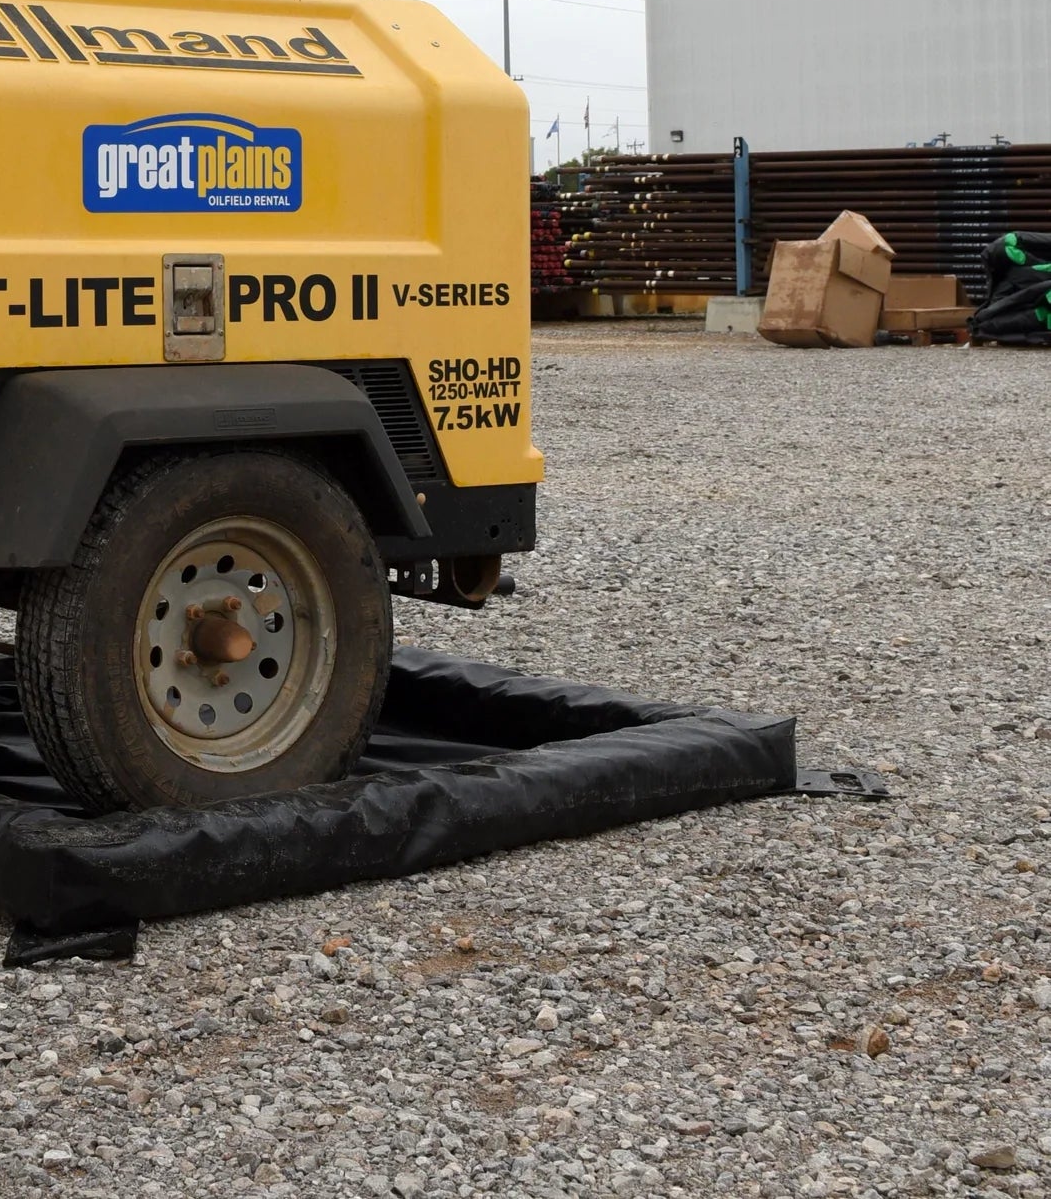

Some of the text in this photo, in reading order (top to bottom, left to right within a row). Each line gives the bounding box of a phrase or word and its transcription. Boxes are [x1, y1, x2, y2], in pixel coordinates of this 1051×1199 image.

[98, 136, 291, 198] great plains
[208, 195, 290, 206] OILFIELD RENTAL
[229, 274, 337, 322] PRO
[352, 275, 378, 320] II
[392, 283, 510, 307] V-SERIES
[428, 357, 521, 383] SHO-HD
[428, 381, 521, 401] 1250-WATT
[433, 403, 520, 431] 7.5kW
